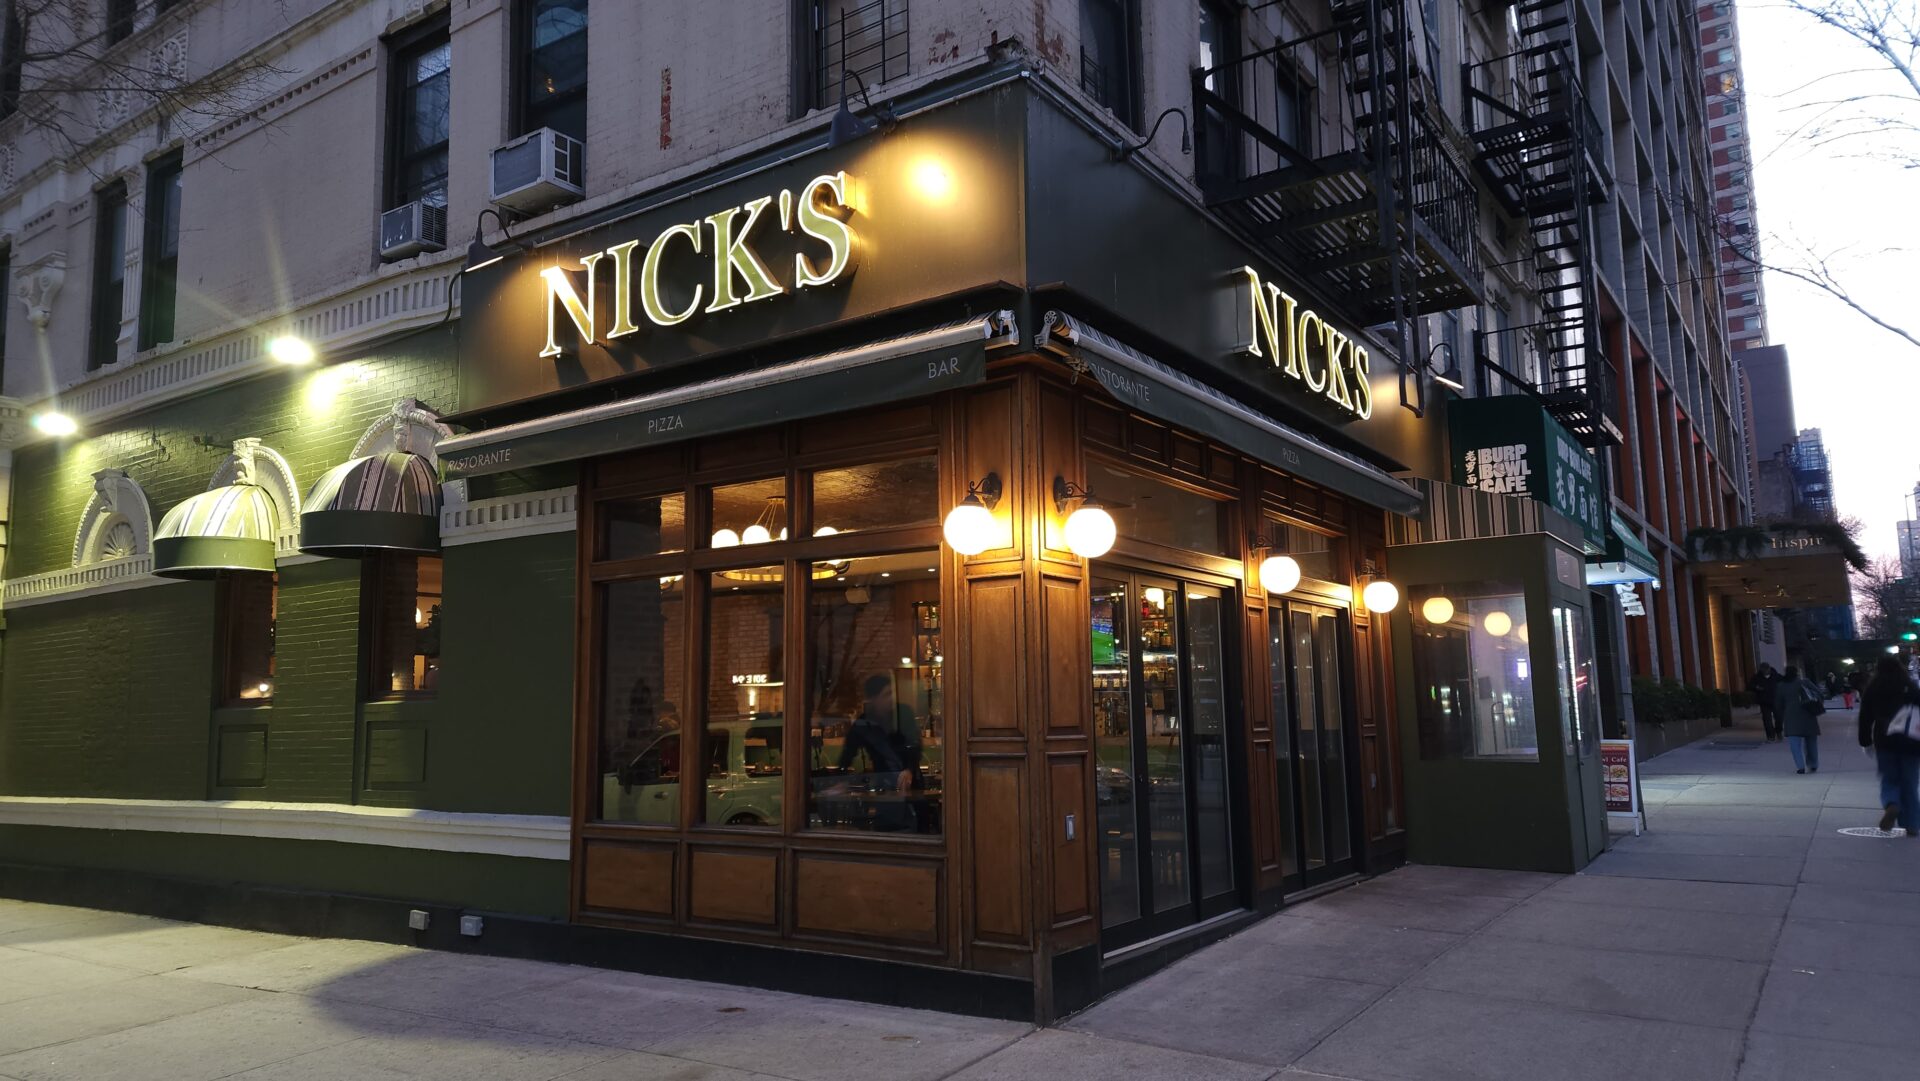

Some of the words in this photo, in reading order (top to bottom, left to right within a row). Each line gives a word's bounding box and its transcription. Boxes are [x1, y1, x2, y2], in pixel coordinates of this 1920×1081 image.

[539, 170, 851, 358] NICK'S
[1244, 265, 1373, 420] NICK'S
[928, 357, 961, 379] BAR
[648, 415, 684, 433] PIZZA
[446, 448, 511, 471] RISTORANTE
[1478, 444, 1527, 464] BURP
[1464, 450, 1479, 490] 老罗面
[1479, 459, 1531, 480] BOWL
[1480, 475, 1527, 493] CAFE
